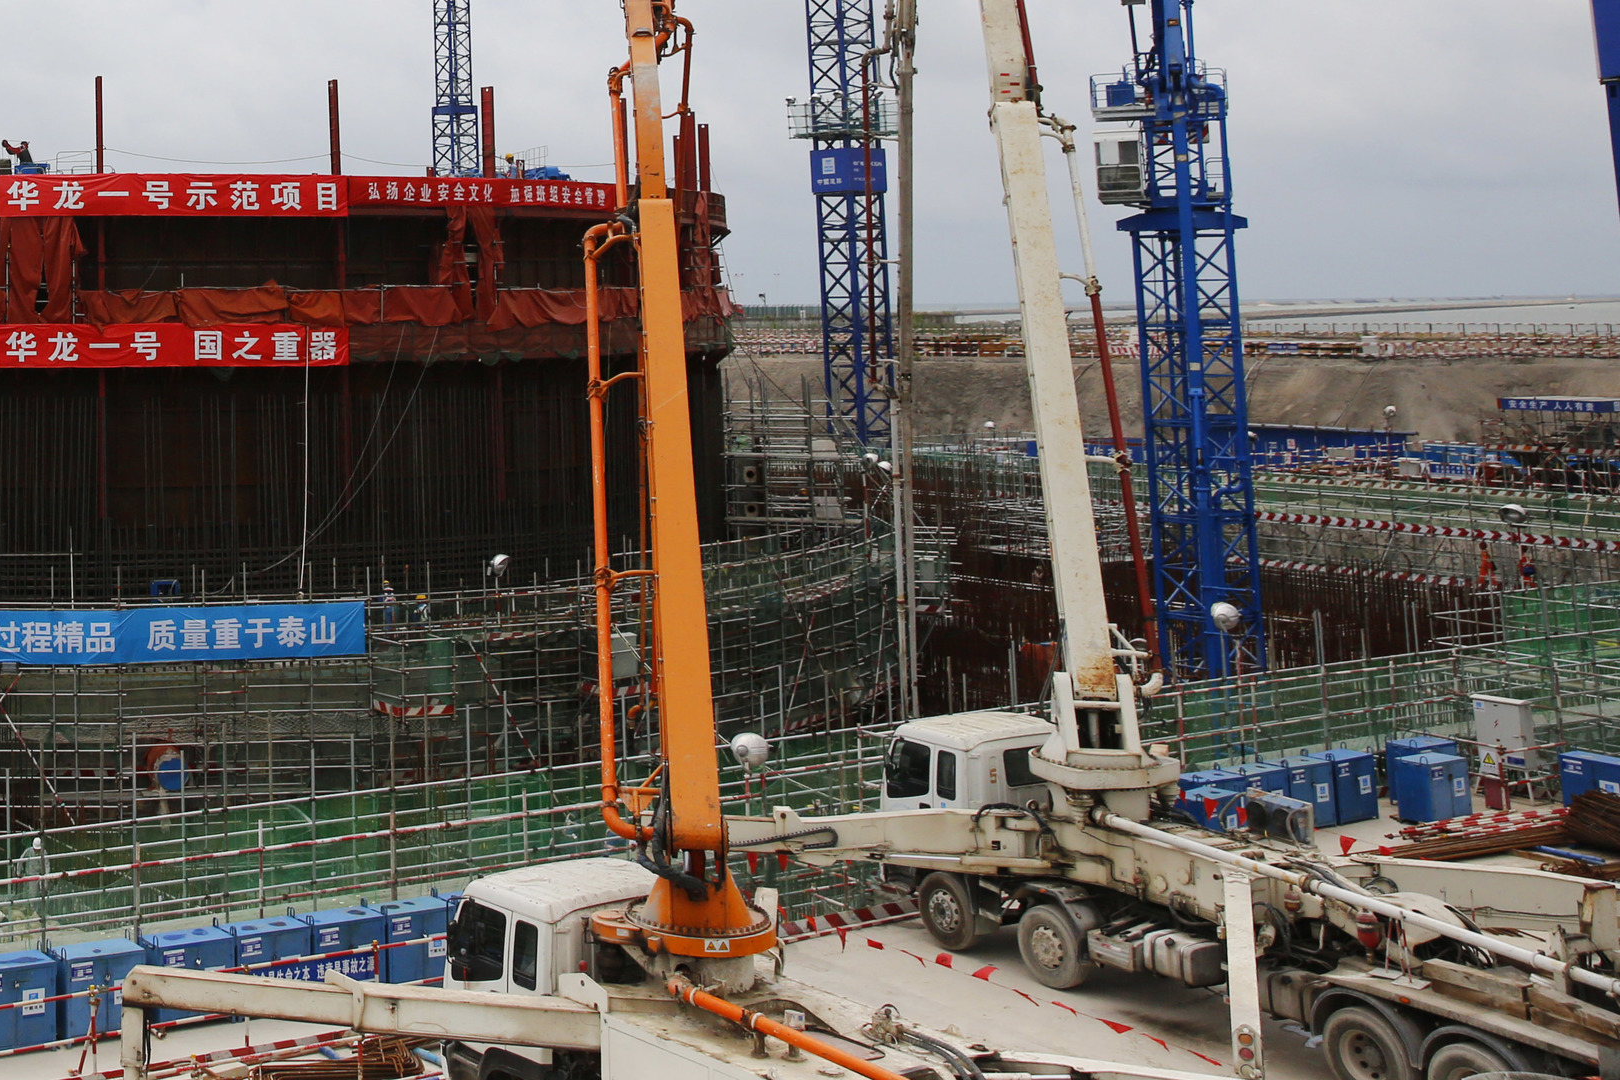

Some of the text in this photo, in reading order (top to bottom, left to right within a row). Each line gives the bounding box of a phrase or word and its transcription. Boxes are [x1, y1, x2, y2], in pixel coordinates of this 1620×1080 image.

[6, 180, 337, 211] 华龙一号示范项目
[368, 181, 606, 207] 弘扬企业安全文化 加强班组安全管理
[5, 330, 337, 362] 华龙一号 国之重器
[1508, 400, 1548, 409] 安全生产
[147, 615, 337, 651] 质量重于泰山
